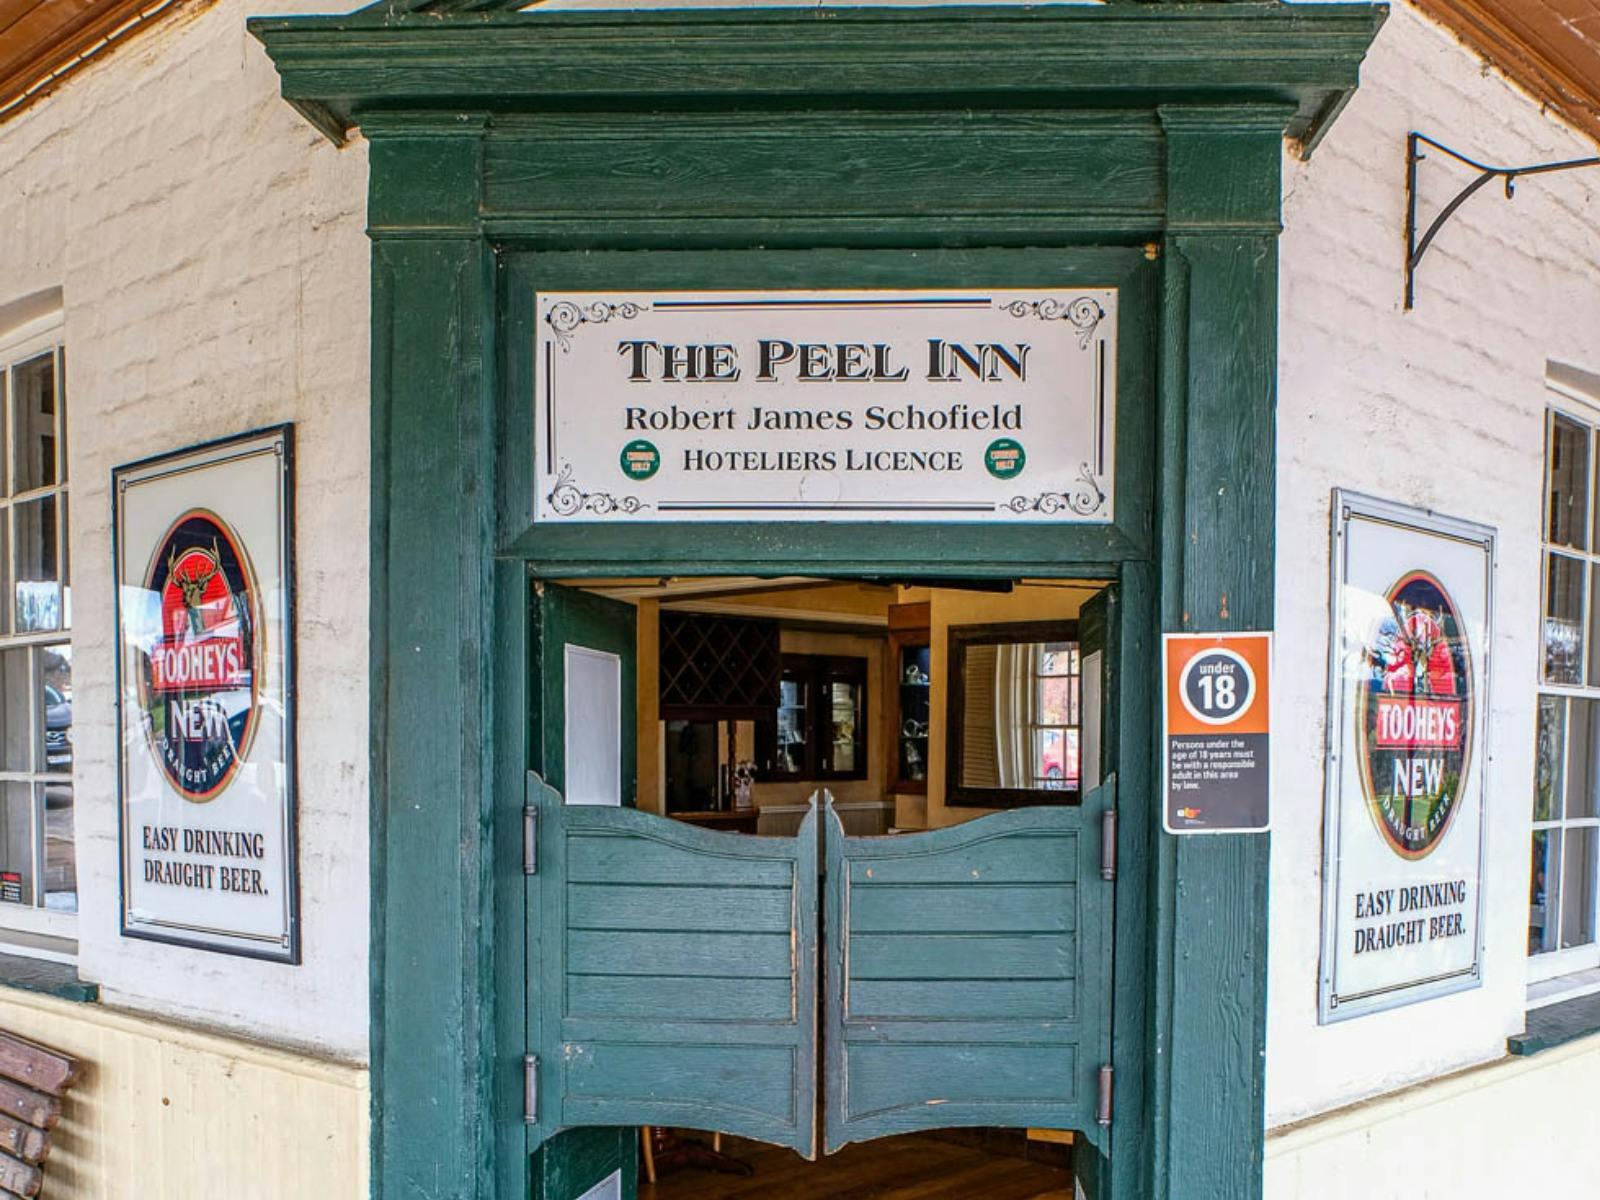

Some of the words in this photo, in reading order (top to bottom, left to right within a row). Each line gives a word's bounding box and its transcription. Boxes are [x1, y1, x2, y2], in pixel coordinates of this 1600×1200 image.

[618, 339, 740, 382] THE
[757, 338, 909, 382] PEEL
[926, 338, 1031, 382] INN
[624, 406, 735, 431] Robert
[748, 406, 852, 431] James
[864, 404, 1022, 431] Schofield
[683, 450, 836, 471] HOTELIERS
[845, 449, 963, 471] LICENCE
[151, 642, 239, 684] TOOHEYS
[1199, 662, 1235, 674] under
[1198, 675, 1236, 710] 18
[170, 699, 226, 739] NEW
[1378, 703, 1456, 741] TOOHEYS
[1172, 740, 1204, 749] Persons
[1206, 740, 1229, 748] under
[1231, 739, 1245, 748] the
[1172, 751, 1187, 761] age
[1189, 750, 1197, 759] of
[1199, 750, 1208, 759] 18
[1209, 751, 1232, 760] years
[1233, 750, 1254, 758] must
[1172, 761, 1182, 770] be
[1184, 760, 1202, 769] with
[1209, 759, 1255, 770] responsible
[1172, 771, 1193, 779] adult
[1194, 770, 1202, 779] in
[1203, 770, 1219, 779] this
[1220, 771, 1239, 779] area
[1394, 757, 1445, 797] NEW
[1172, 781, 1182, 791] by
[1183, 781, 1201, 789] law.
[143, 825, 178, 851] EASY
[184, 829, 264, 858] DRINKING
[144, 859, 214, 889] DRAUGHT
[220, 866, 268, 895] BEER.
[1355, 889, 1395, 918] EASY
[1399, 880, 1466, 912] DRINKING
[1354, 918, 1426, 954] DRAUGHT
[1429, 913, 1466, 940] BEER.
